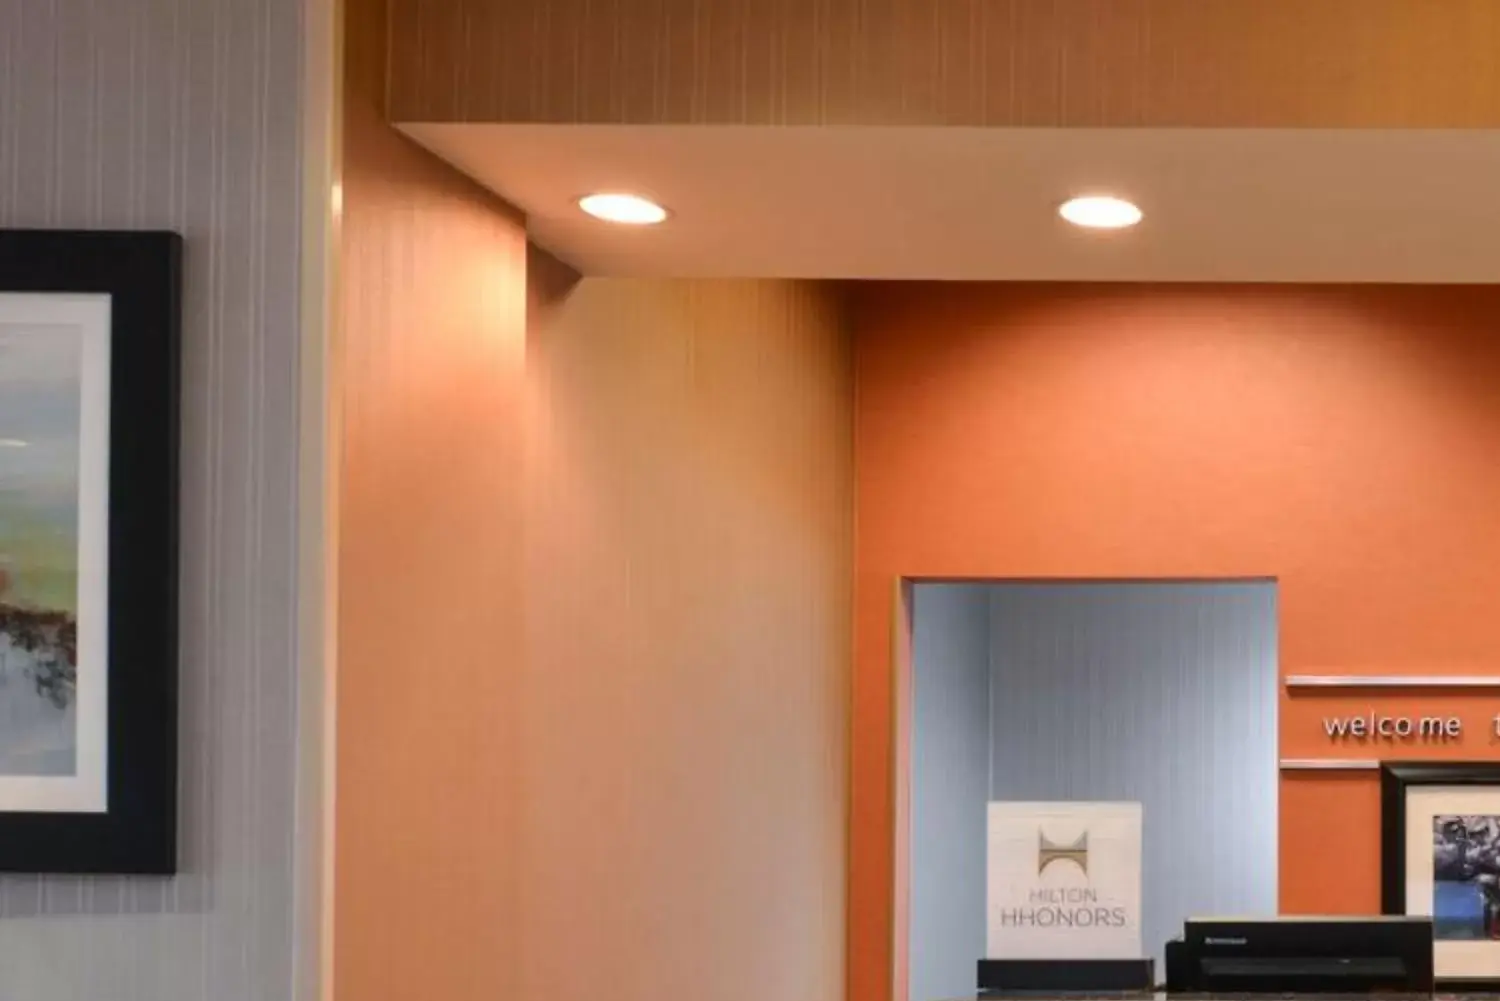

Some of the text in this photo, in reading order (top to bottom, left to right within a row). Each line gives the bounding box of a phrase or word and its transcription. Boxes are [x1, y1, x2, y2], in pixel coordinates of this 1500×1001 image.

[1323, 709, 1462, 738] welcome
[1028, 887, 1098, 903] HILTON
[1001, 907, 1126, 927] HHONORS
